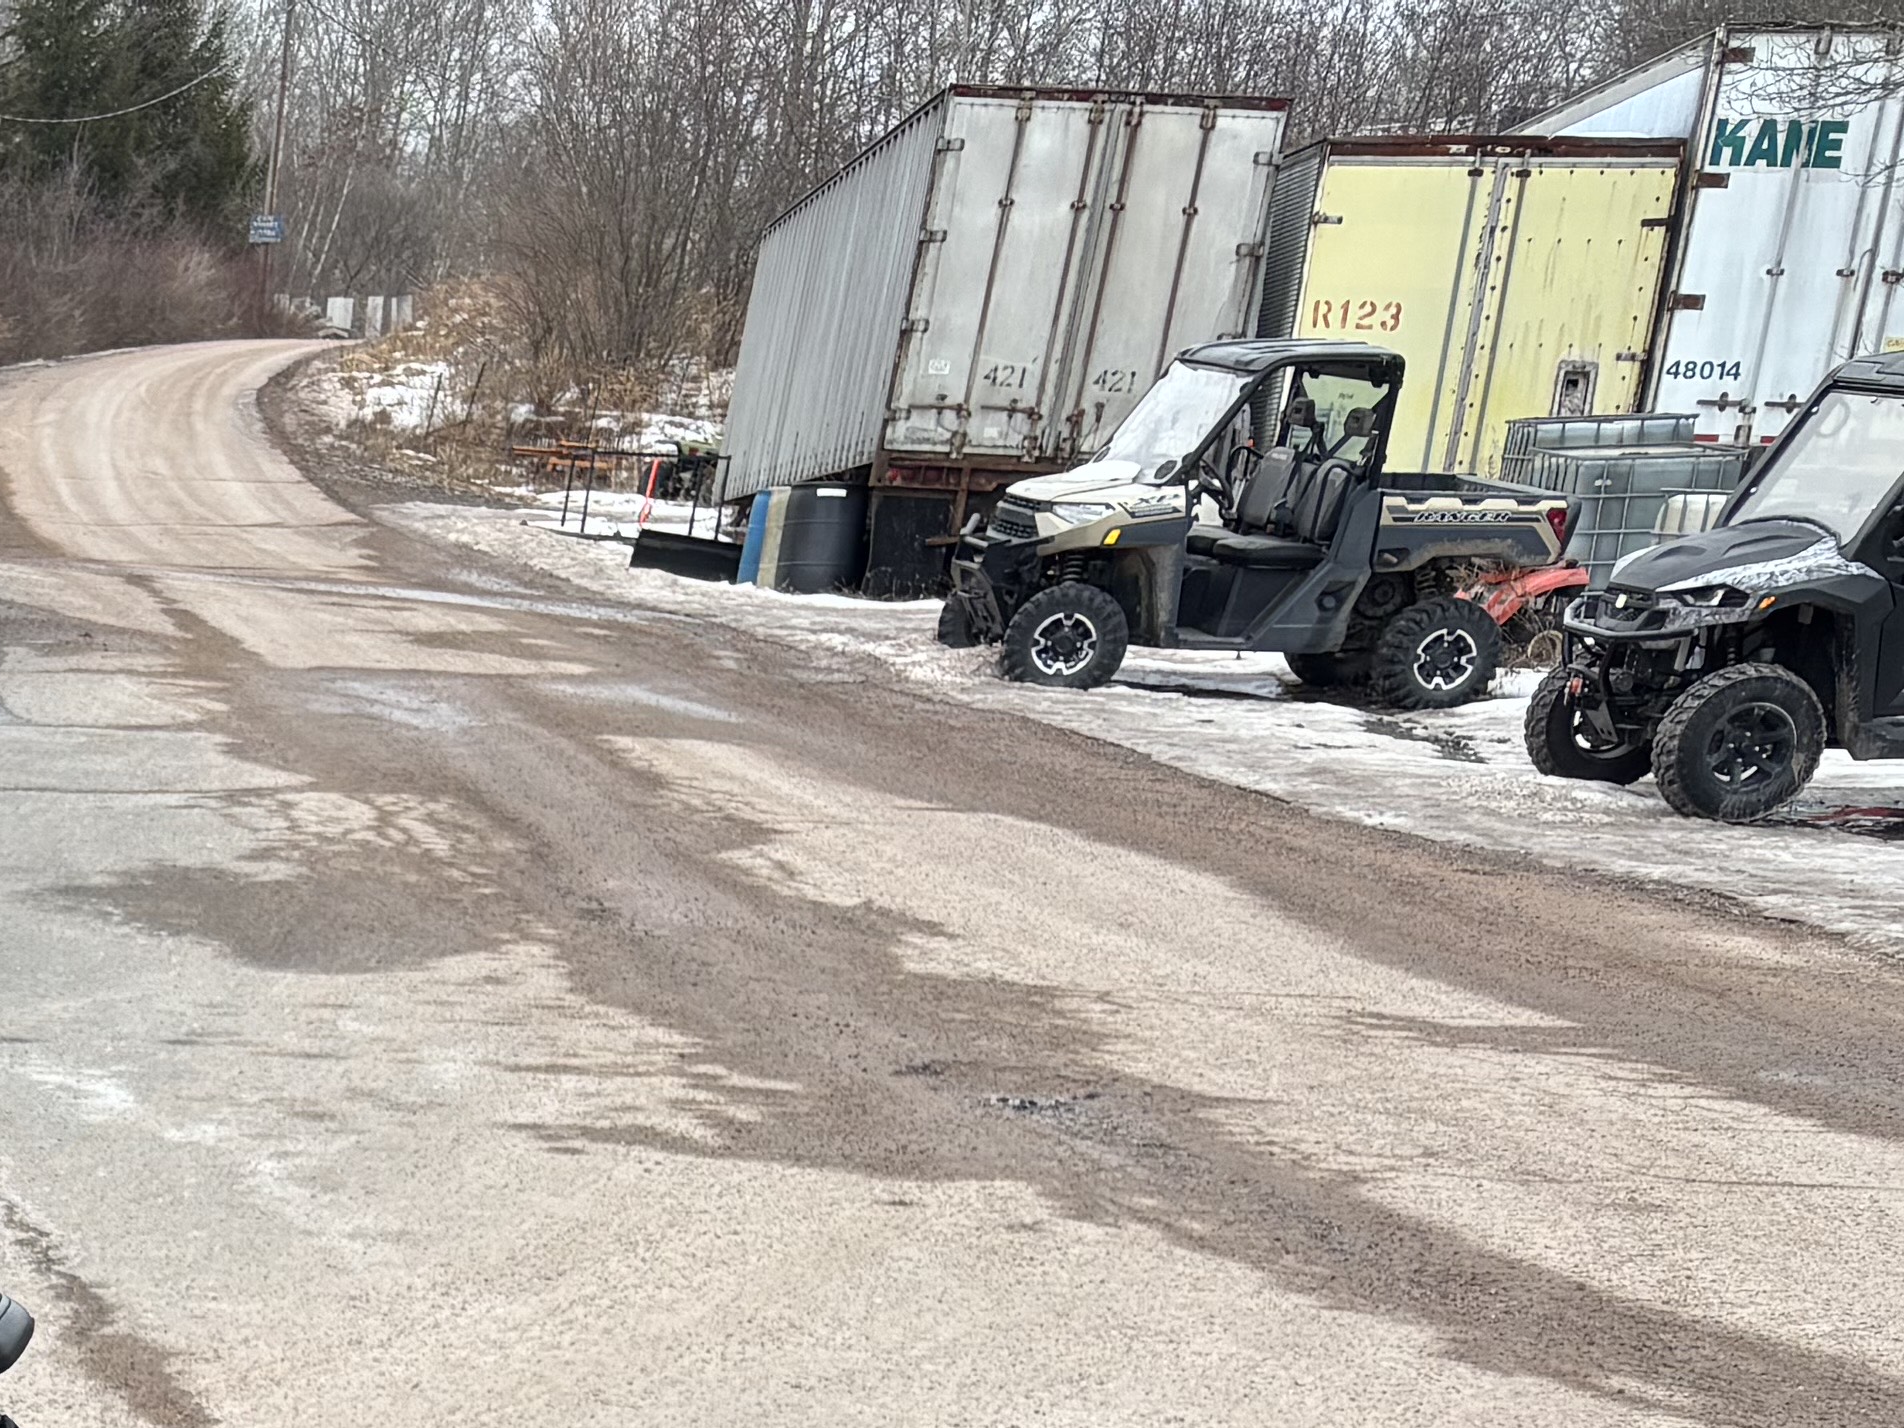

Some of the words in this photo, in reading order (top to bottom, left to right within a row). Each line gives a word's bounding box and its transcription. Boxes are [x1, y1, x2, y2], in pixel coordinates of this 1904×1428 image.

[1709, 118, 1849, 168] KANE
[1312, 299, 1403, 332] R123
[983, 364, 1027, 389] 421
[1092, 369, 1137, 395] 421
[1666, 360, 1742, 381] 48014
[1413, 511, 1512, 523] RANGER
